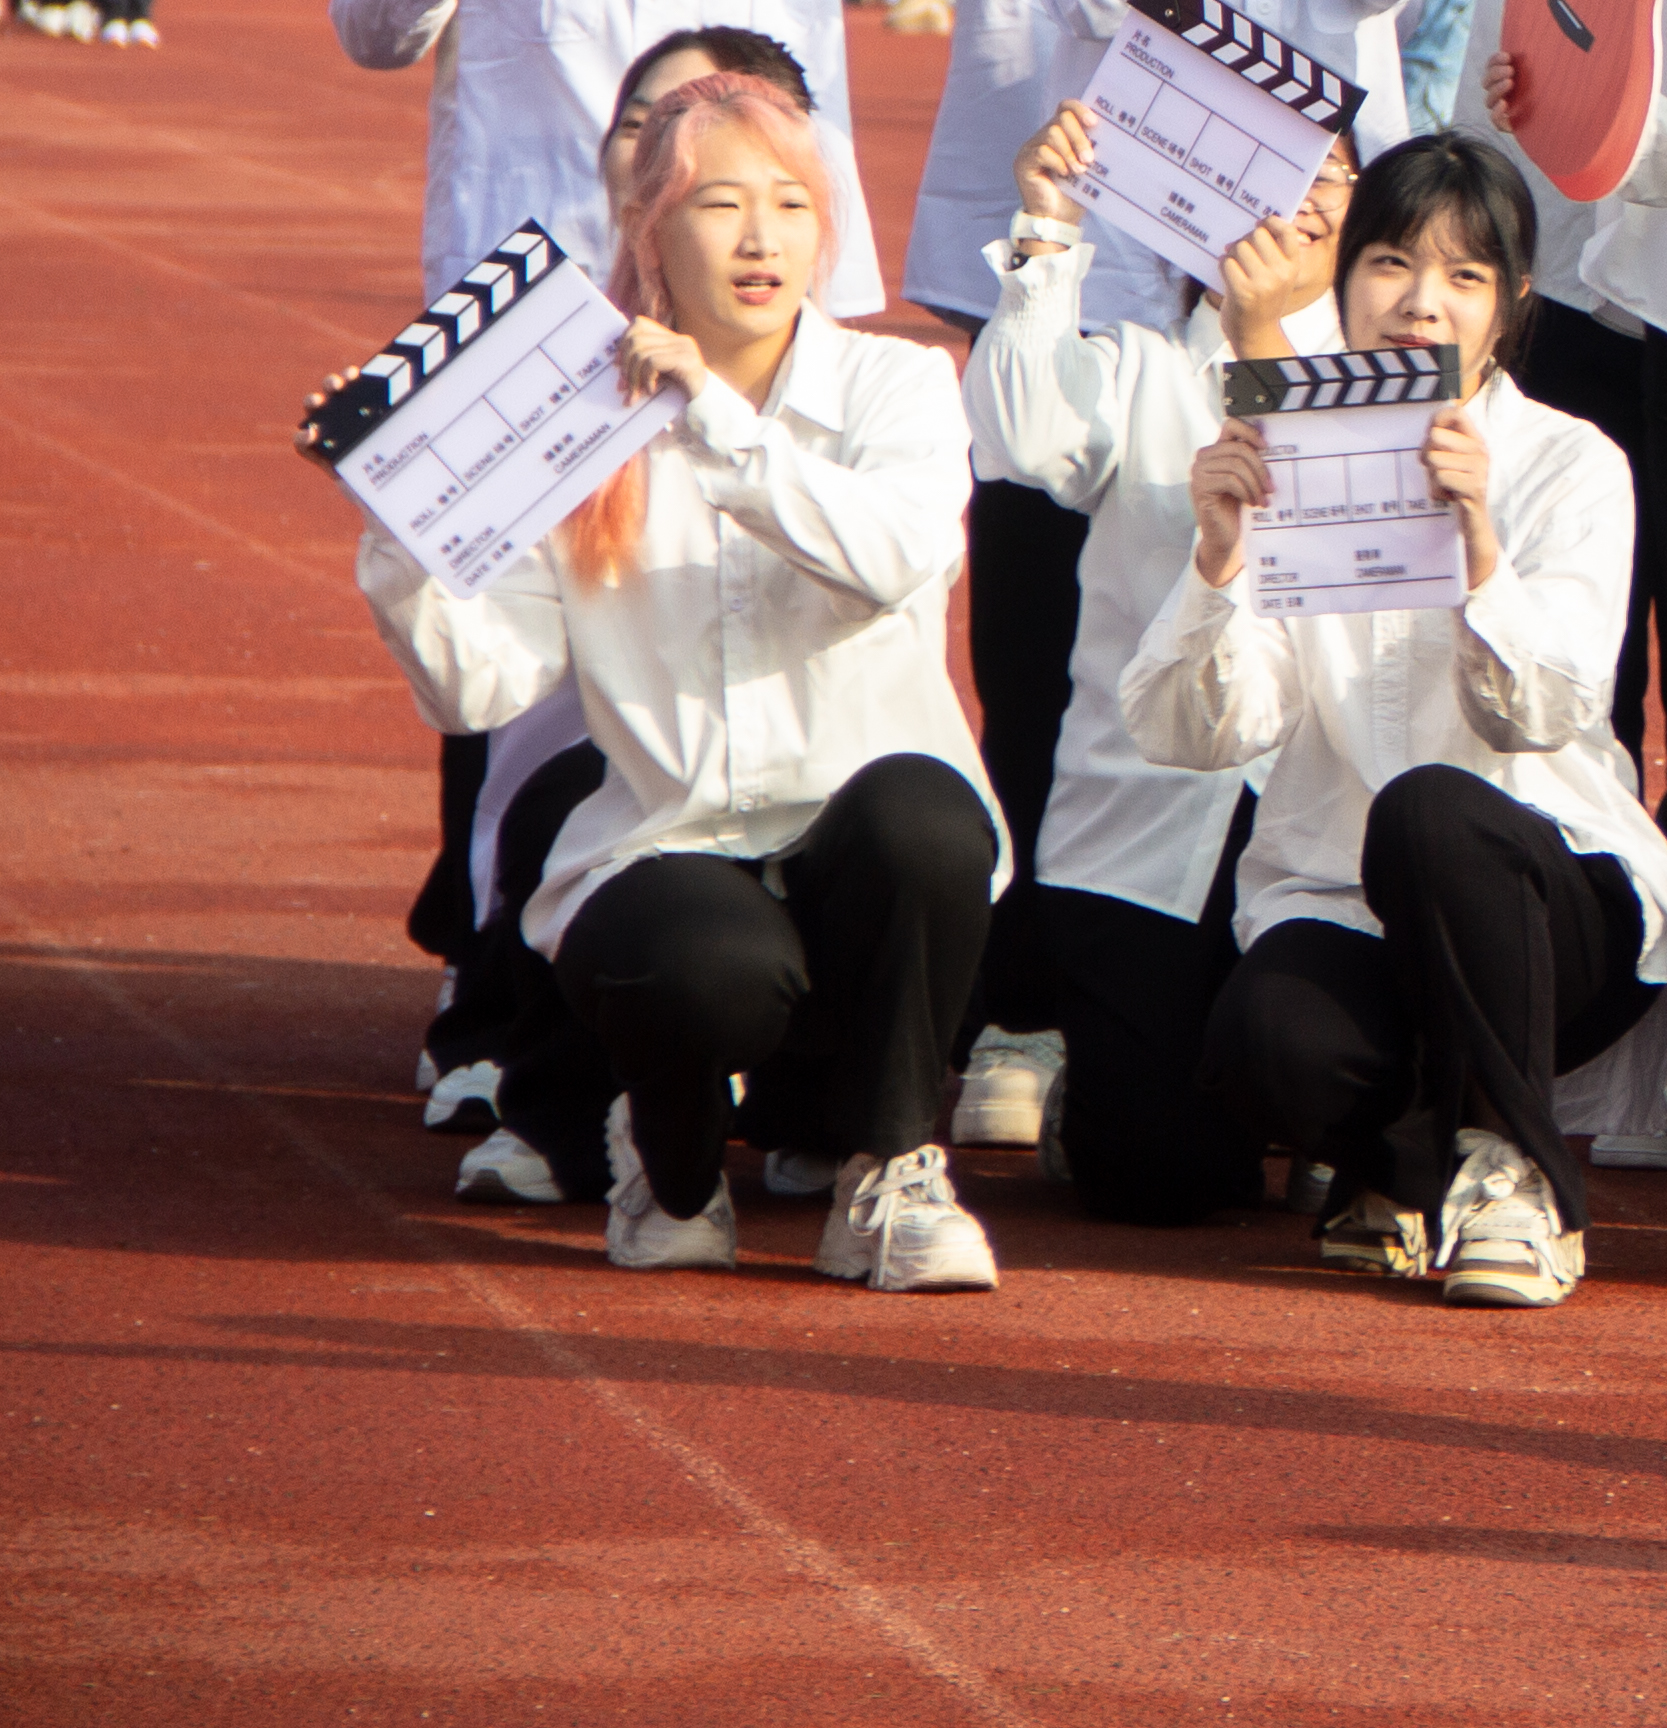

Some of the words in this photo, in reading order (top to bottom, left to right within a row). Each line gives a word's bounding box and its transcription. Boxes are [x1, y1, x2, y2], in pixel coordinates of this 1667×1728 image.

[1124, 41, 1174, 79] PRODUCTION
[1095, 95, 1114, 116] ROLL
[1141, 126, 1169, 149] SCENE
[1190, 157, 1213, 176] SHOT
[1240, 189, 1260, 209] TAKE
[1160, 206, 1209, 243] CAMERAMAN
